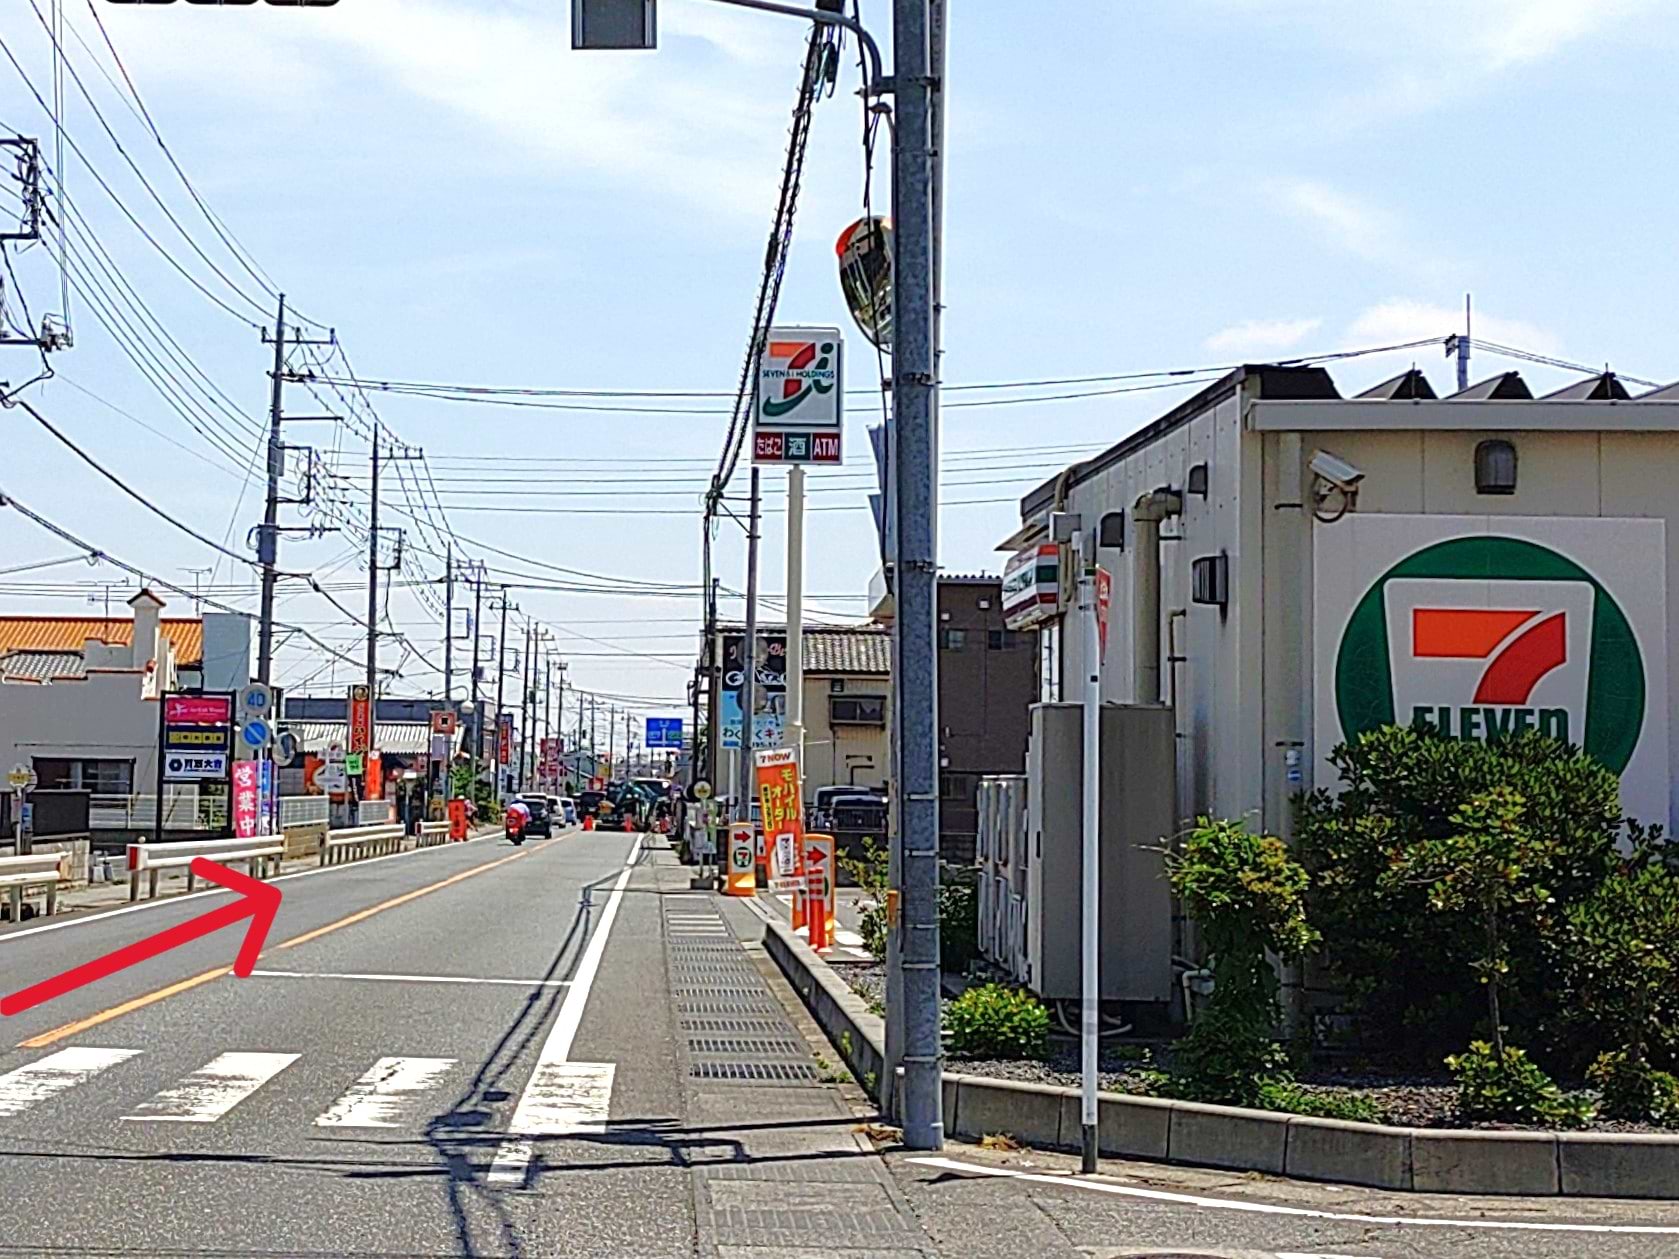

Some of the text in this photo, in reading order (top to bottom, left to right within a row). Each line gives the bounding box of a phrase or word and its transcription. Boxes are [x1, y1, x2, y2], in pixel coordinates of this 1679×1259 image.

[762, 370, 785, 378] SEVEN
[796, 370, 835, 378] HOLDINGS
[756, 437, 782, 456] たばこ
[788, 437, 806, 456] 酒
[813, 438, 839, 456] ATM
[1413, 608, 1567, 706] 7
[246, 692, 266, 707] 40
[767, 752, 791, 762] NOW
[235, 765, 255, 836] 営業中
